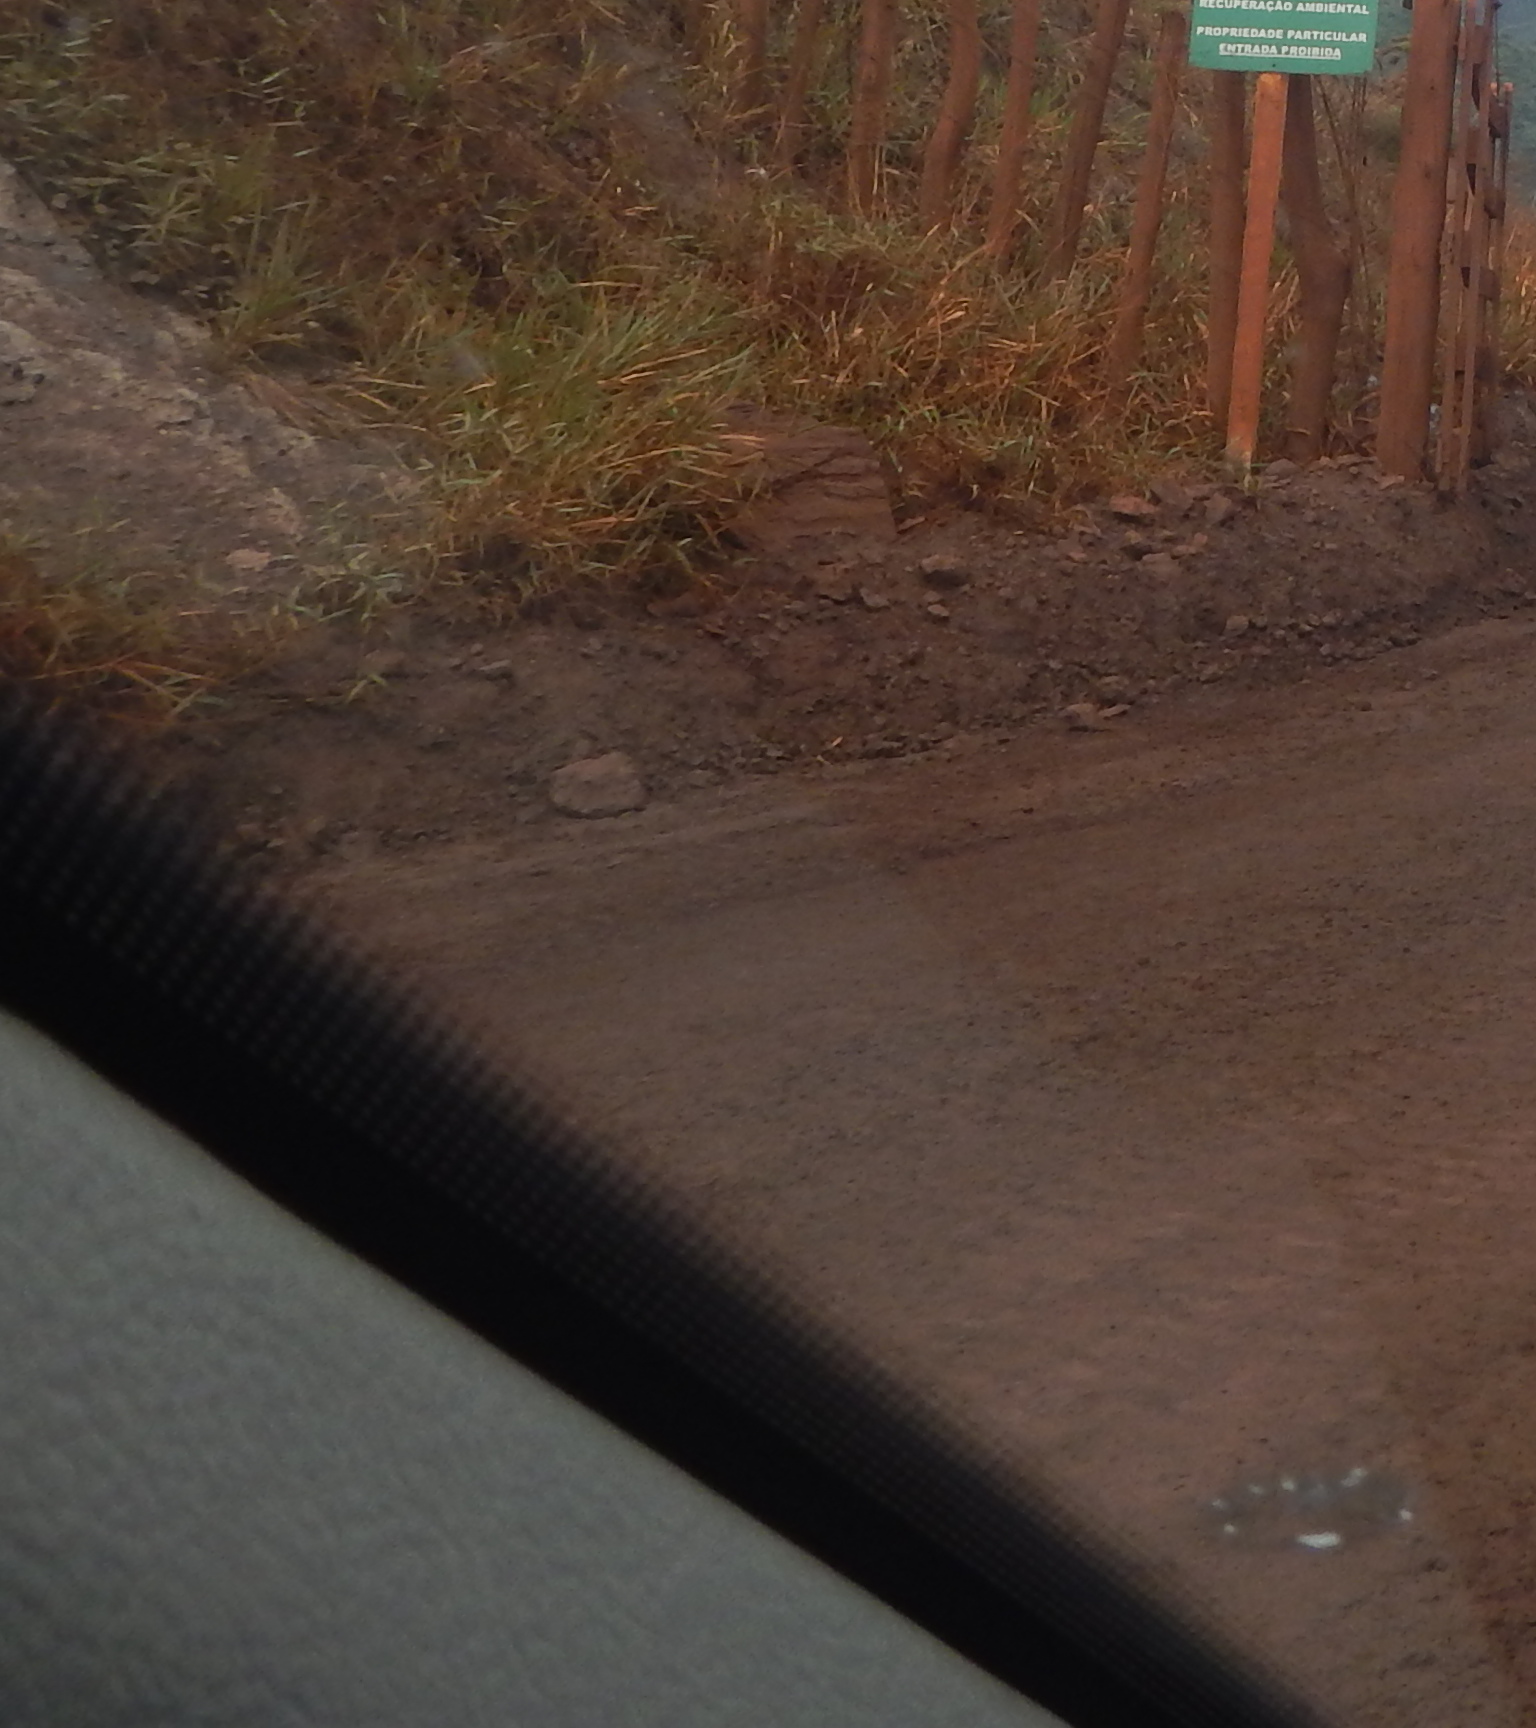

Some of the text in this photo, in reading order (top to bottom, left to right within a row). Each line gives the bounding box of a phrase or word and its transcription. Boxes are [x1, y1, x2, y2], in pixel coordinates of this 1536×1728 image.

[1296, 3, 1369, 15] AMBIENTAL
[1197, 26, 1366, 43] PROPRIEDADE PARTICULAR
[1219, 43, 1341, 60] ENTRADA PROIBIDA
